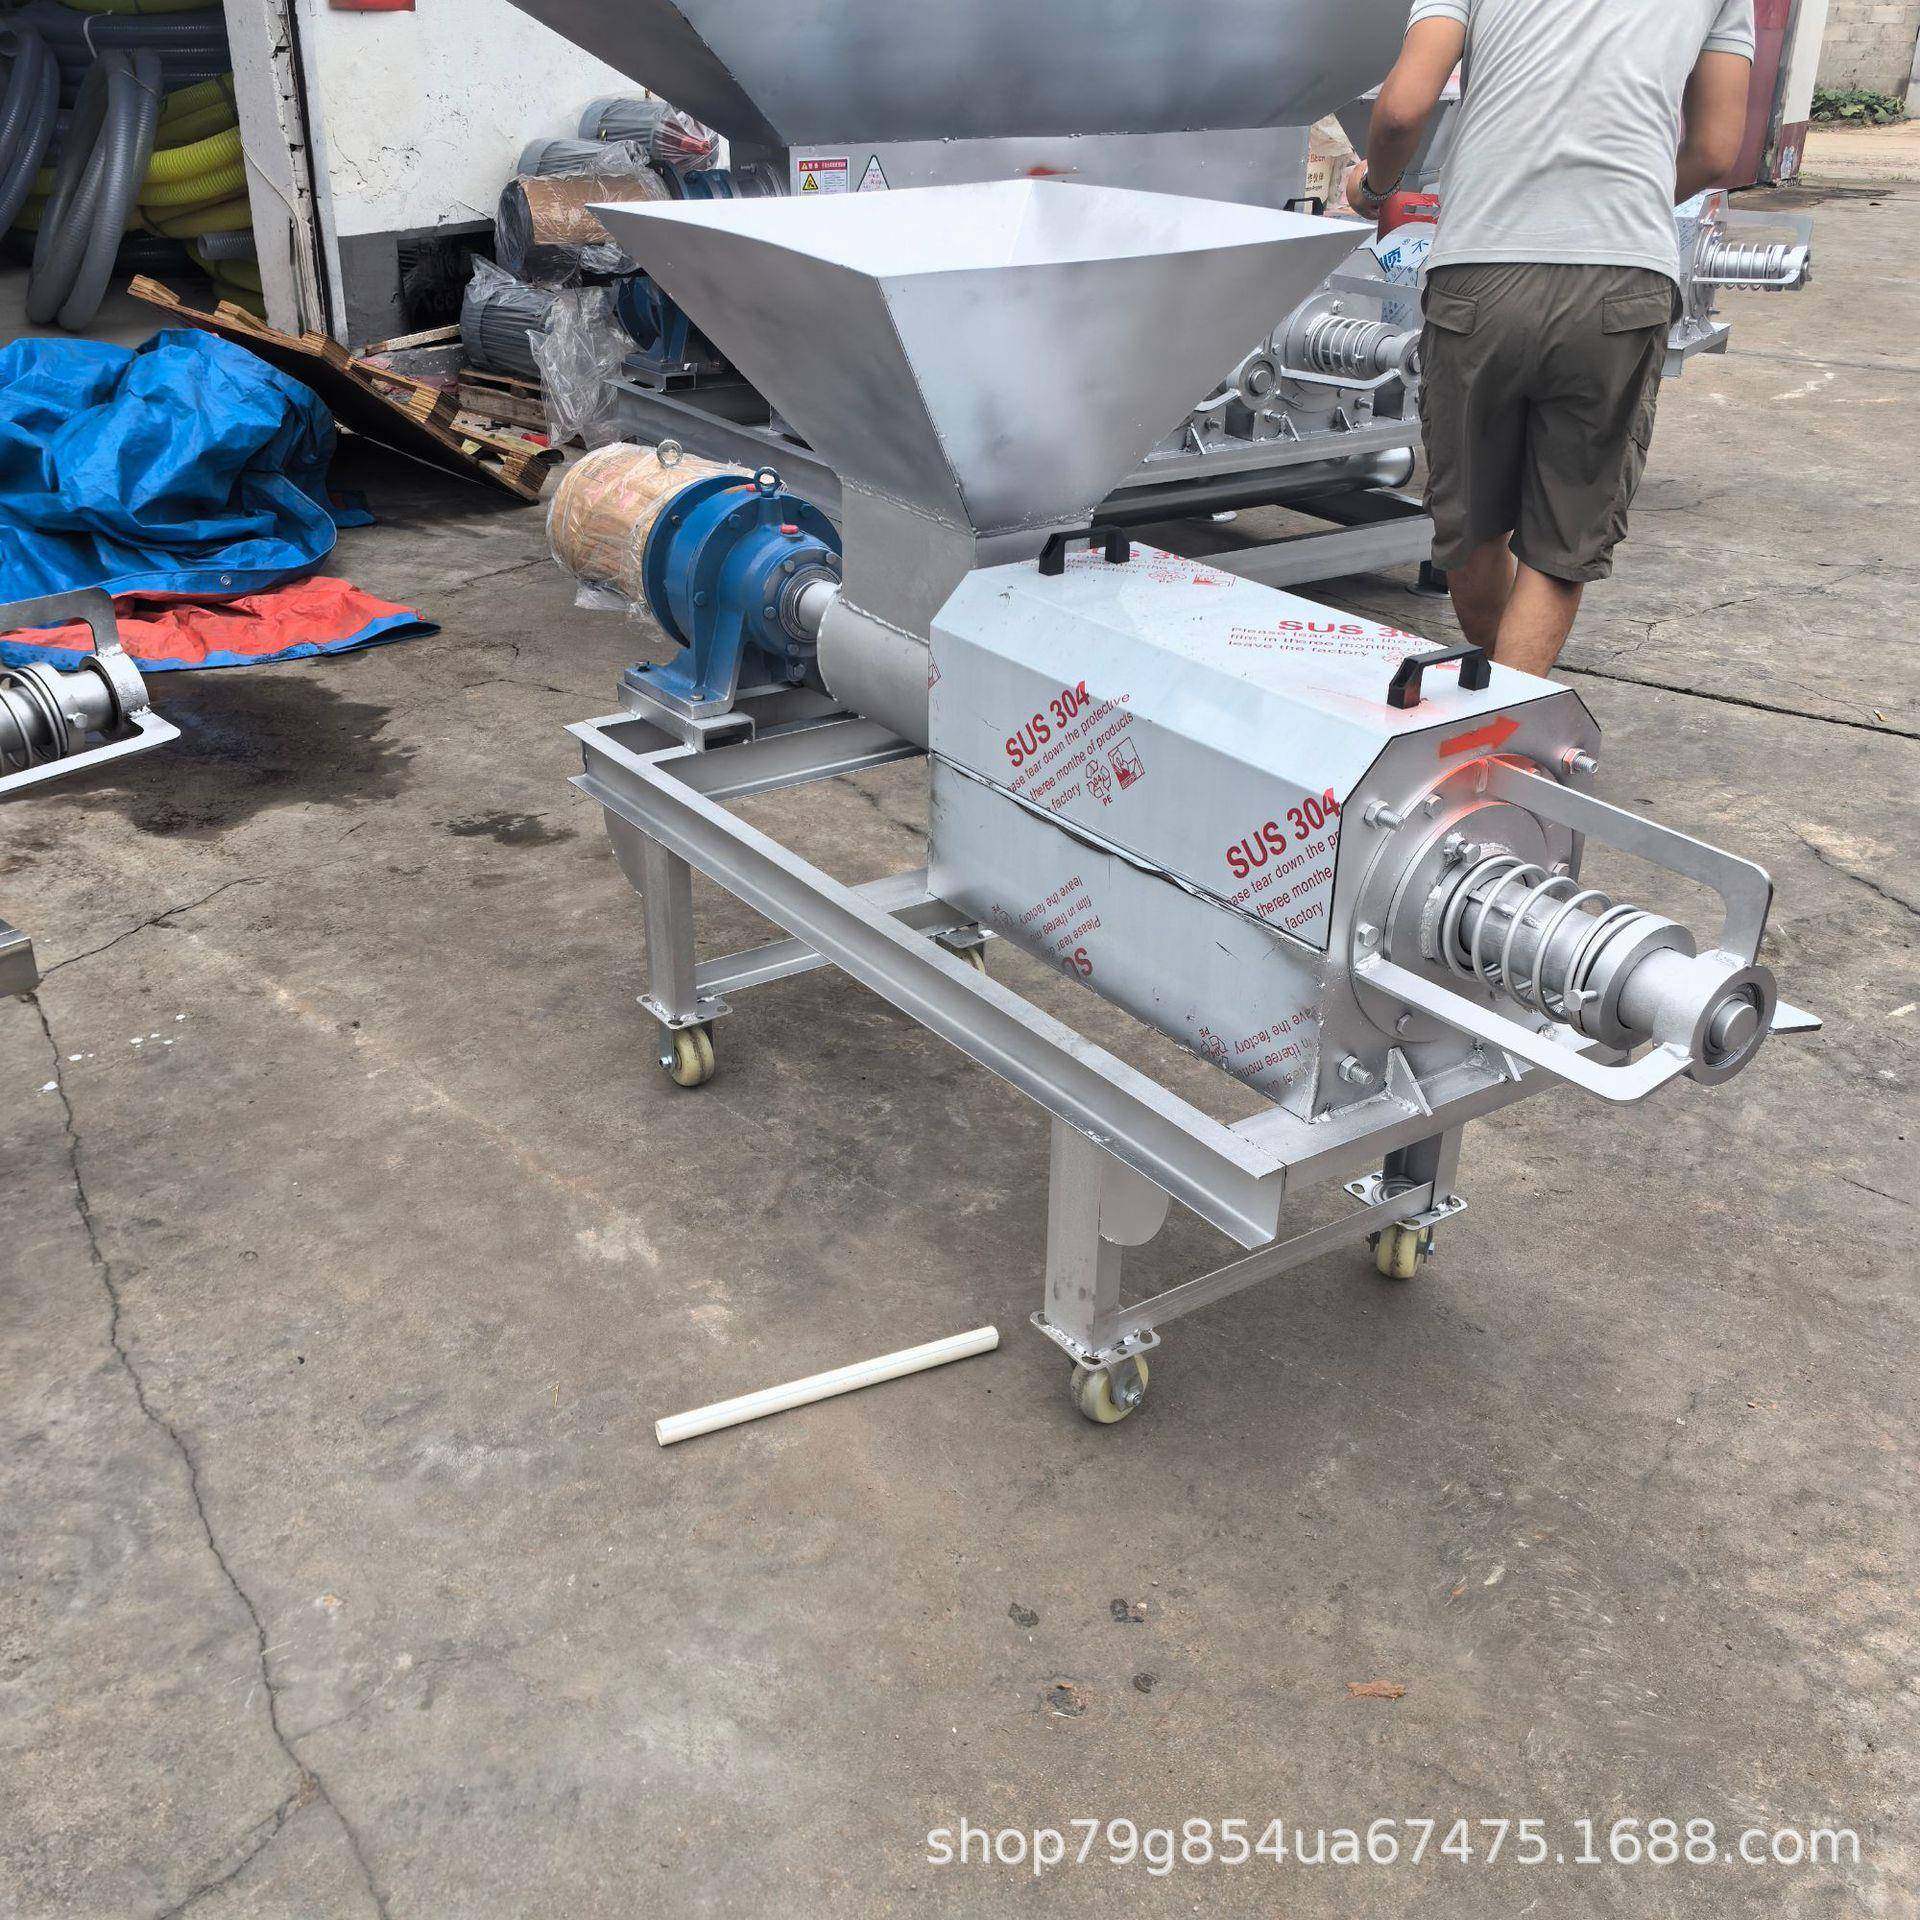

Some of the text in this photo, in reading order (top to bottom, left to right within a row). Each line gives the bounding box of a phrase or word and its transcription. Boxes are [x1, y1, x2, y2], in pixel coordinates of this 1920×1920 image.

[1231, 626, 1286, 637] Please
[1278, 620, 1364, 636] SUS
[1228, 640, 1370, 658] leave the factory
[1005, 680, 1090, 768] SUS 304
[1025, 760, 1042, 780] tear
[1043, 741, 1066, 765] down
[1064, 728, 1080, 746] the
[1080, 693, 1130, 736] protective
[1029, 712, 1134, 801] theree monthe of products
[1050, 782, 1081, 811] factory
[1102, 795, 1113, 806] PE
[1226, 787, 1341, 879] SUS 304
[1251, 872, 1273, 892] tear
[1275, 855, 1305, 879] down
[1305, 841, 1326, 860] the
[1018, 875, 1084, 927] leave the factory
[1076, 895, 1093, 911] film
[1256, 866, 1332, 918] theree monthe
[1067, 906, 1076, 918] in
[1285, 901, 1324, 931] factory
[1042, 913, 1068, 936] theree
[1073, 915, 1101, 939] Please
[1057, 935, 1073, 952] tear
[1198, 1026, 1210, 1038] PE
[1271, 1019, 1292, 1036] the
[1234, 1030, 1271, 1055] factory
[1265, 1043, 1302, 1067] theree
